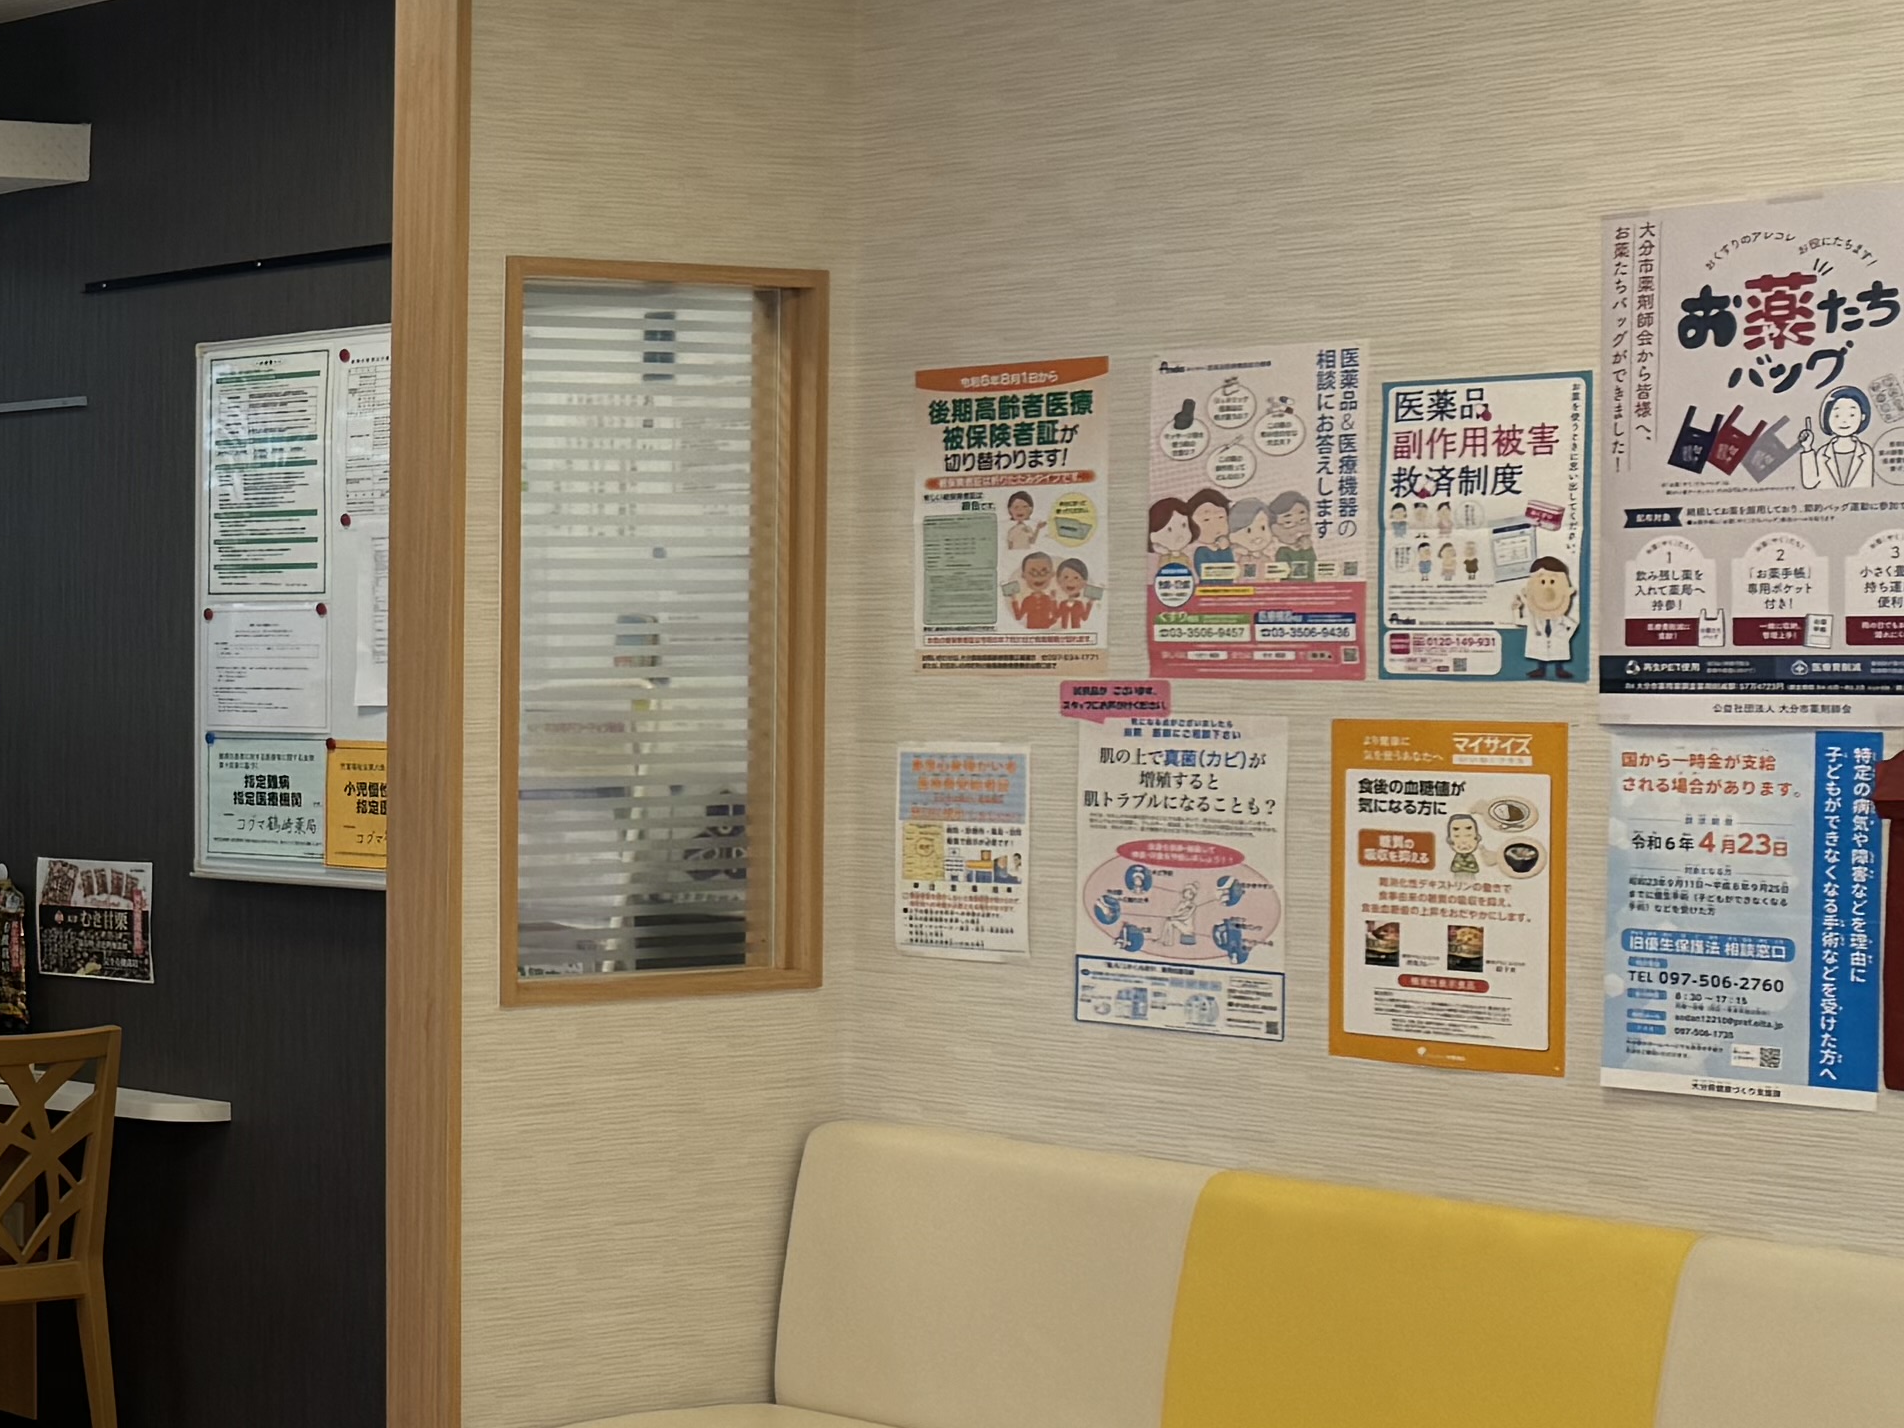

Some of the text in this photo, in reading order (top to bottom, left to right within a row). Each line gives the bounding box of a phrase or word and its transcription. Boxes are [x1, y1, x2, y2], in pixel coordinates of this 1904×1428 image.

[1704, 231, 1878, 271] おくすりのアレコレ お役にたちます!
[1678, 272, 1901, 351] お薬たち
[1611, 226, 1630, 475] お薬たちバッグができました!
[1728, 340, 1854, 394] バッグ
[928, 390, 1094, 425] 後期高齢者医療
[1394, 388, 1489, 422] 医薬品
[943, 424, 1078, 450] 被保険者証が
[1316, 349, 1335, 539] 相談にお答えします
[1339, 347, 1359, 538] 医薬品&医療機器の
[1392, 422, 1560, 460] 副作用被害
[944, 448, 1068, 472] 切り替わります!
[1390, 463, 1523, 498] 救済制度
[1776, 549, 1785, 562] 2
[1891, 546, 1901, 559] 3
[1635, 570, 1704, 581] 飲み残し薬を
[1747, 583, 1812, 594] 専用ポケット
[1427, 637, 1496, 648] 0120-149-931
[1453, 735, 1532, 754] マイサイズ
[1099, 746, 1266, 770] 肌の上で真菌(カビ)が
[1621, 752, 1776, 772] 国から一時金が支給
[244, 775, 289, 789] 指定難病
[1139, 772, 1219, 791] 増殖すると
[1358, 778, 1466, 797] 食後の血糖値が
[1622, 778, 1801, 798] される場合があります。
[234, 791, 302, 807] 指定医療機関
[1084, 791, 1276, 816] 肌トラブルになることも?
[1358, 798, 1447, 815] 気になる方に
[238, 815, 316, 834] コグマ鶴崎薬局
[1631, 832, 1788, 857] 令和6年4月23日
[1850, 746, 1871, 982] 特定の病気や障害などを理由に
[1819, 746, 1842, 1080] 子どもができなくなる手術などを受けた方へ
[1629, 971, 1784, 992] TEL 097-506-2760
